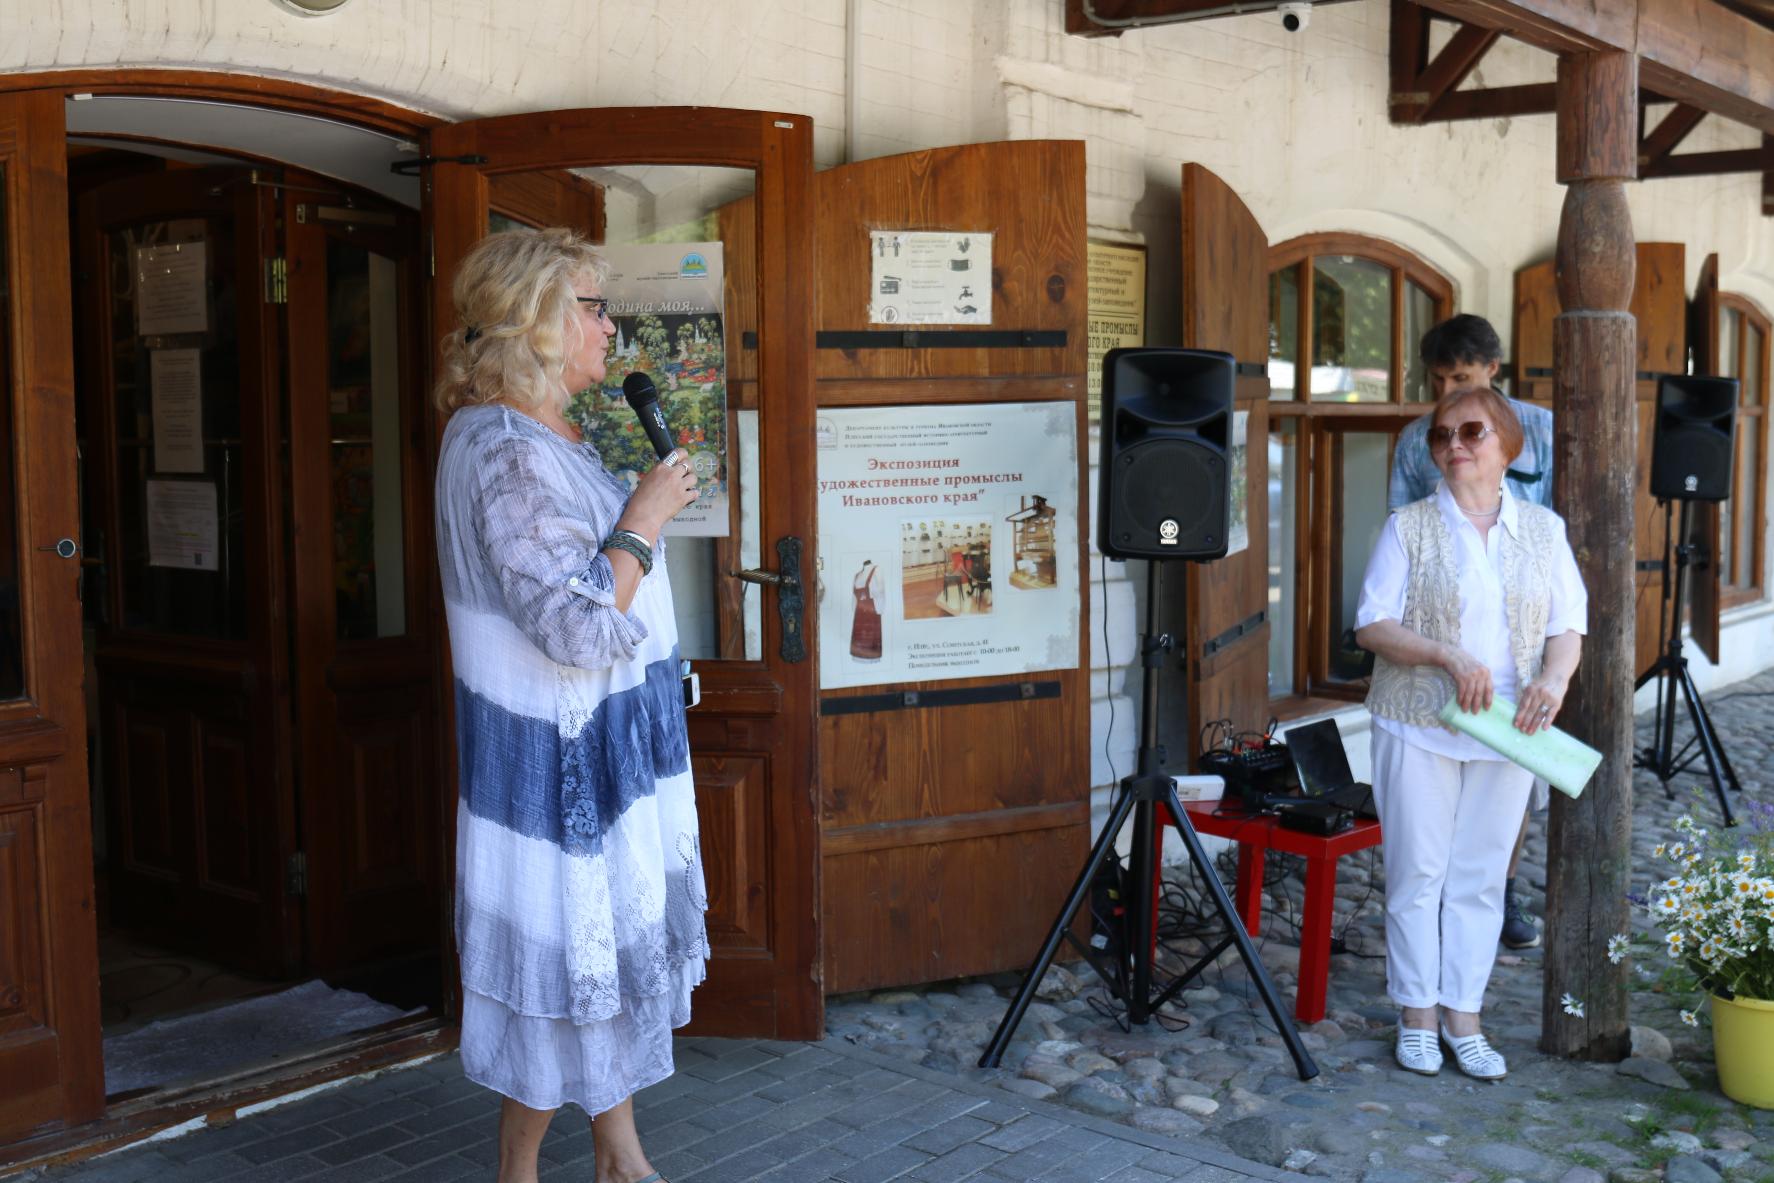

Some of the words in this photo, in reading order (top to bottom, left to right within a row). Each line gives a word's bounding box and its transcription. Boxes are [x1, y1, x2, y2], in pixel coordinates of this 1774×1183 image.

[606, 300, 654, 313] одина
[1088, 320, 1099, 334] ЫЕ
[1100, 321, 1139, 336] ПРОМЫСЛЫ
[1087, 337, 1101, 348] ОГО
[1102, 337, 1120, 349] КРАЯ
[694, 456, 717, 472] 6+
[867, 457, 960, 471] Экспозиция
[817, 477, 940, 493] удожественные
[944, 472, 1024, 488] промыслы
[842, 493, 938, 507] Ивановского
